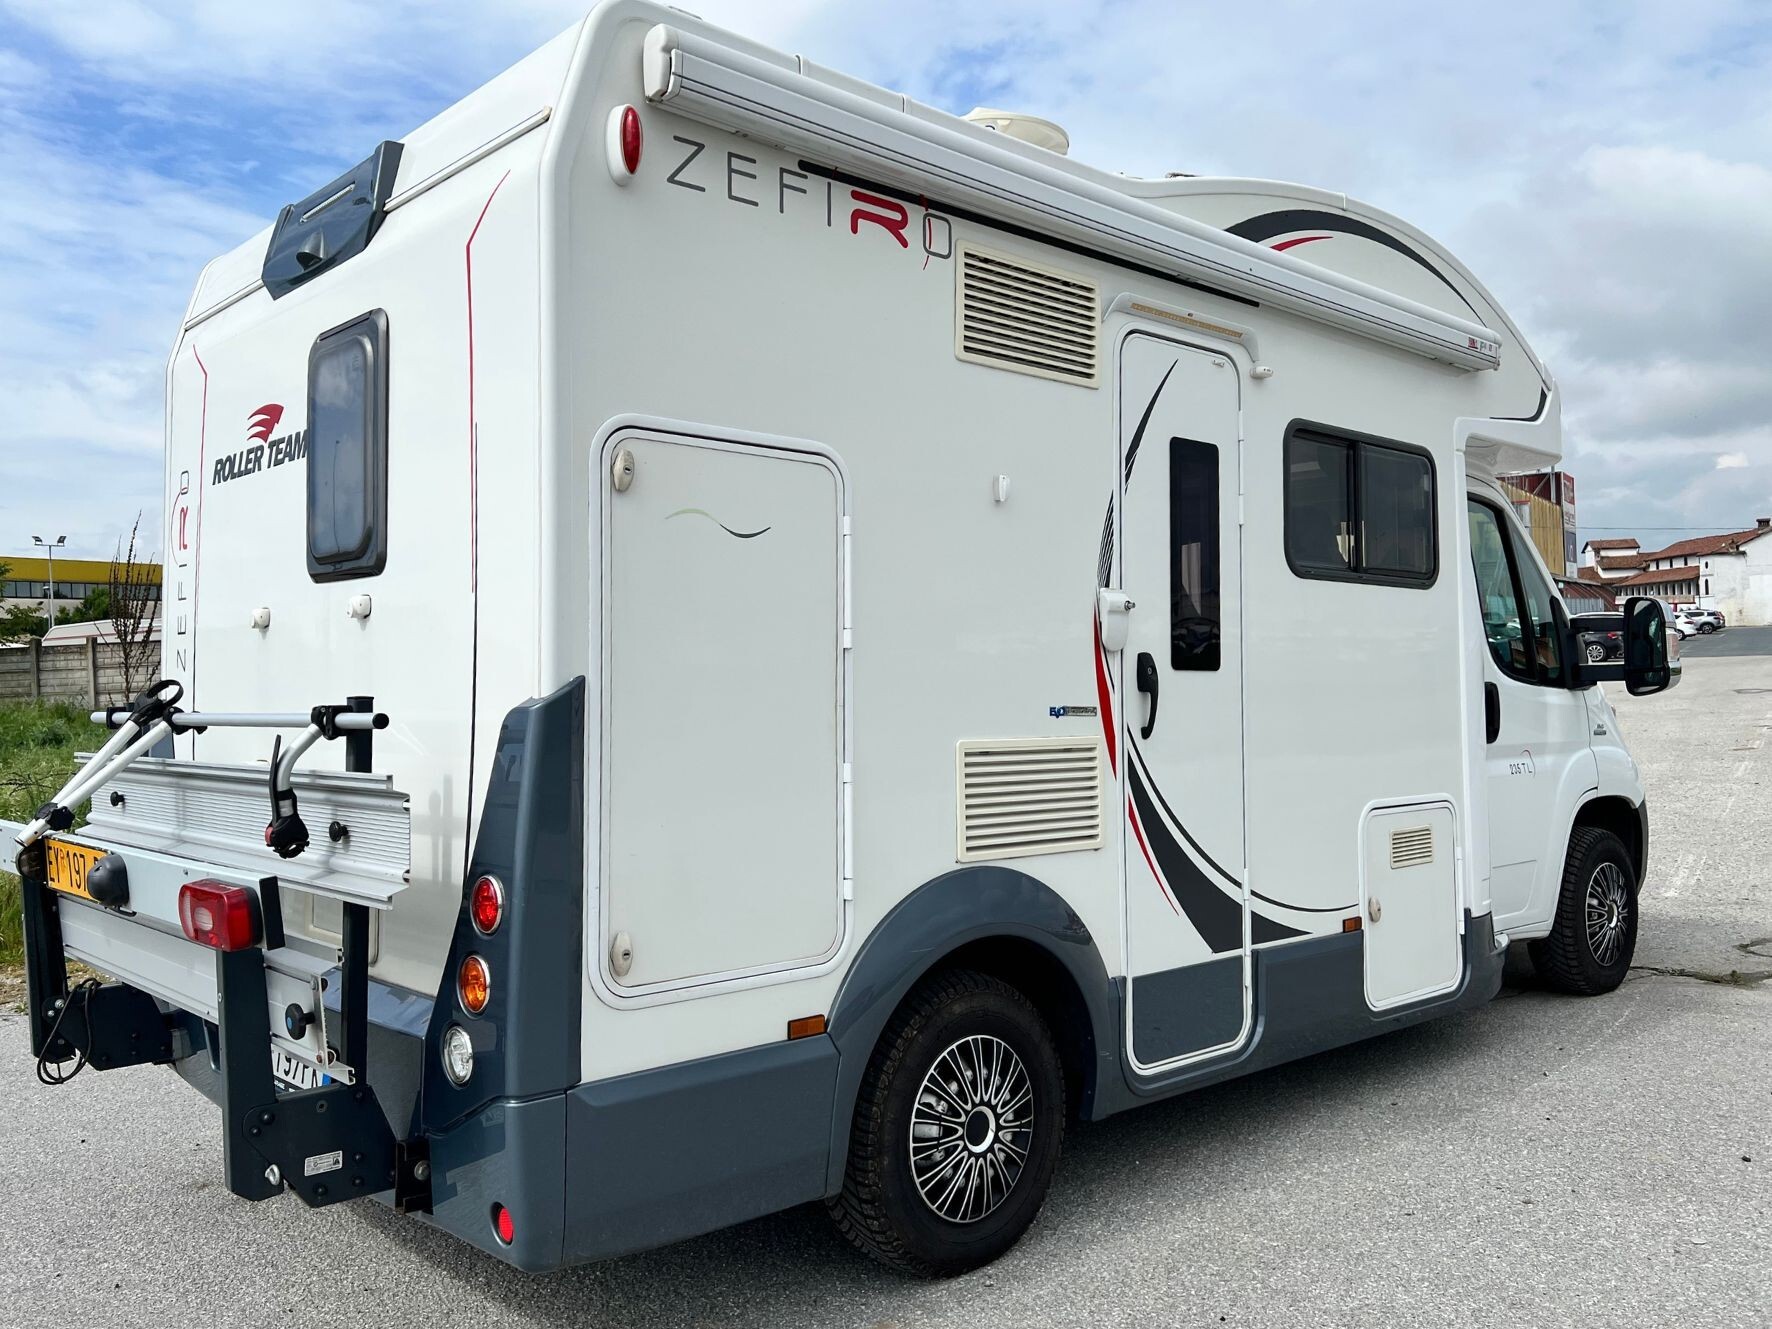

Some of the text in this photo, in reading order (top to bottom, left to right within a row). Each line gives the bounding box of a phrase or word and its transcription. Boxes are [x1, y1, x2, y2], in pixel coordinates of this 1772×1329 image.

[666, 134, 952, 260] ZEFIRO
[212, 428, 309, 486] ROLLER TEAM
[176, 470, 190, 672] ZEFIRO
[66, 850, 87, 892] 197
